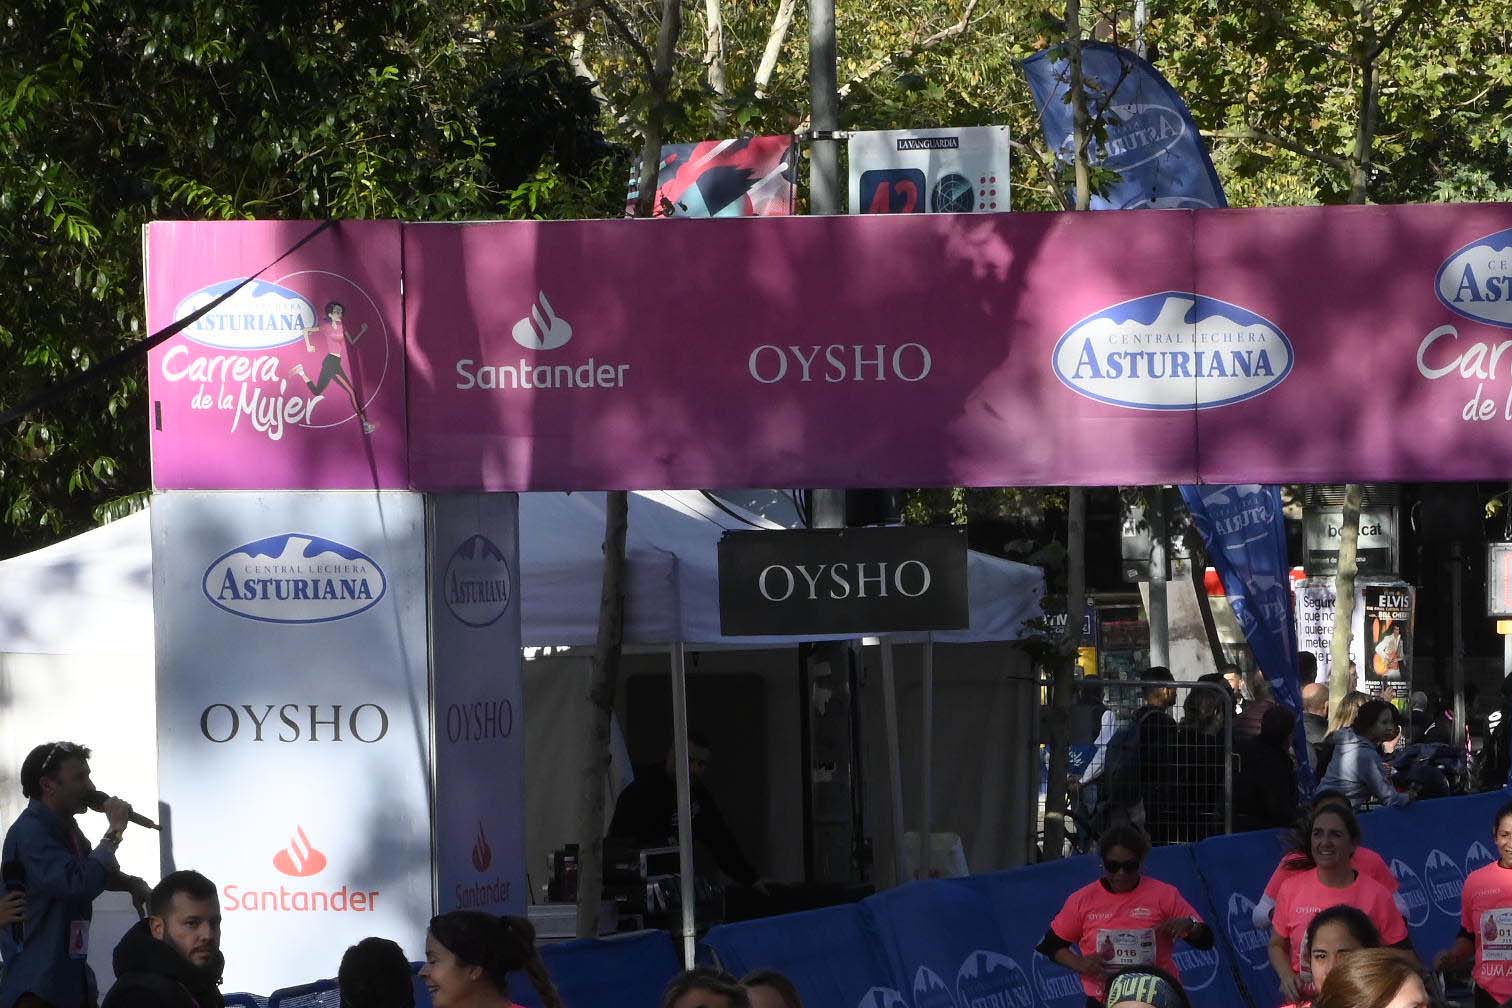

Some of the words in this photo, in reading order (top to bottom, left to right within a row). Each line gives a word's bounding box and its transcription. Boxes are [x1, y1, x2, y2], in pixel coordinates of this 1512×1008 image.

[1108, 332, 1188, 344] CENTRAL
[1191, 330, 1267, 343] LECHERA
[161, 344, 280, 382] Carrera
[456, 357, 630, 390] Santander
[748, 342, 933, 384] OYSHO
[1071, 336, 1275, 380] ASTURIANA
[191, 384, 214, 410] de
[217, 384, 234, 410] la
[230, 378, 325, 441] Mujer
[1461, 382, 1500, 421] de
[216, 567, 374, 602] ASTURIANA
[244, 565, 302, 575] CENTRAL
[308, 564, 367, 574] LECHERA
[758, 560, 931, 602] OYSHO
[1378, 594, 1409, 608] ELVIS
[200, 702, 390, 744] OYSHO
[446, 699, 513, 744] OYSHO
[223, 884, 380, 913] Santander
[455, 876, 512, 911] Santander
[1116, 949, 1137, 957] 016
